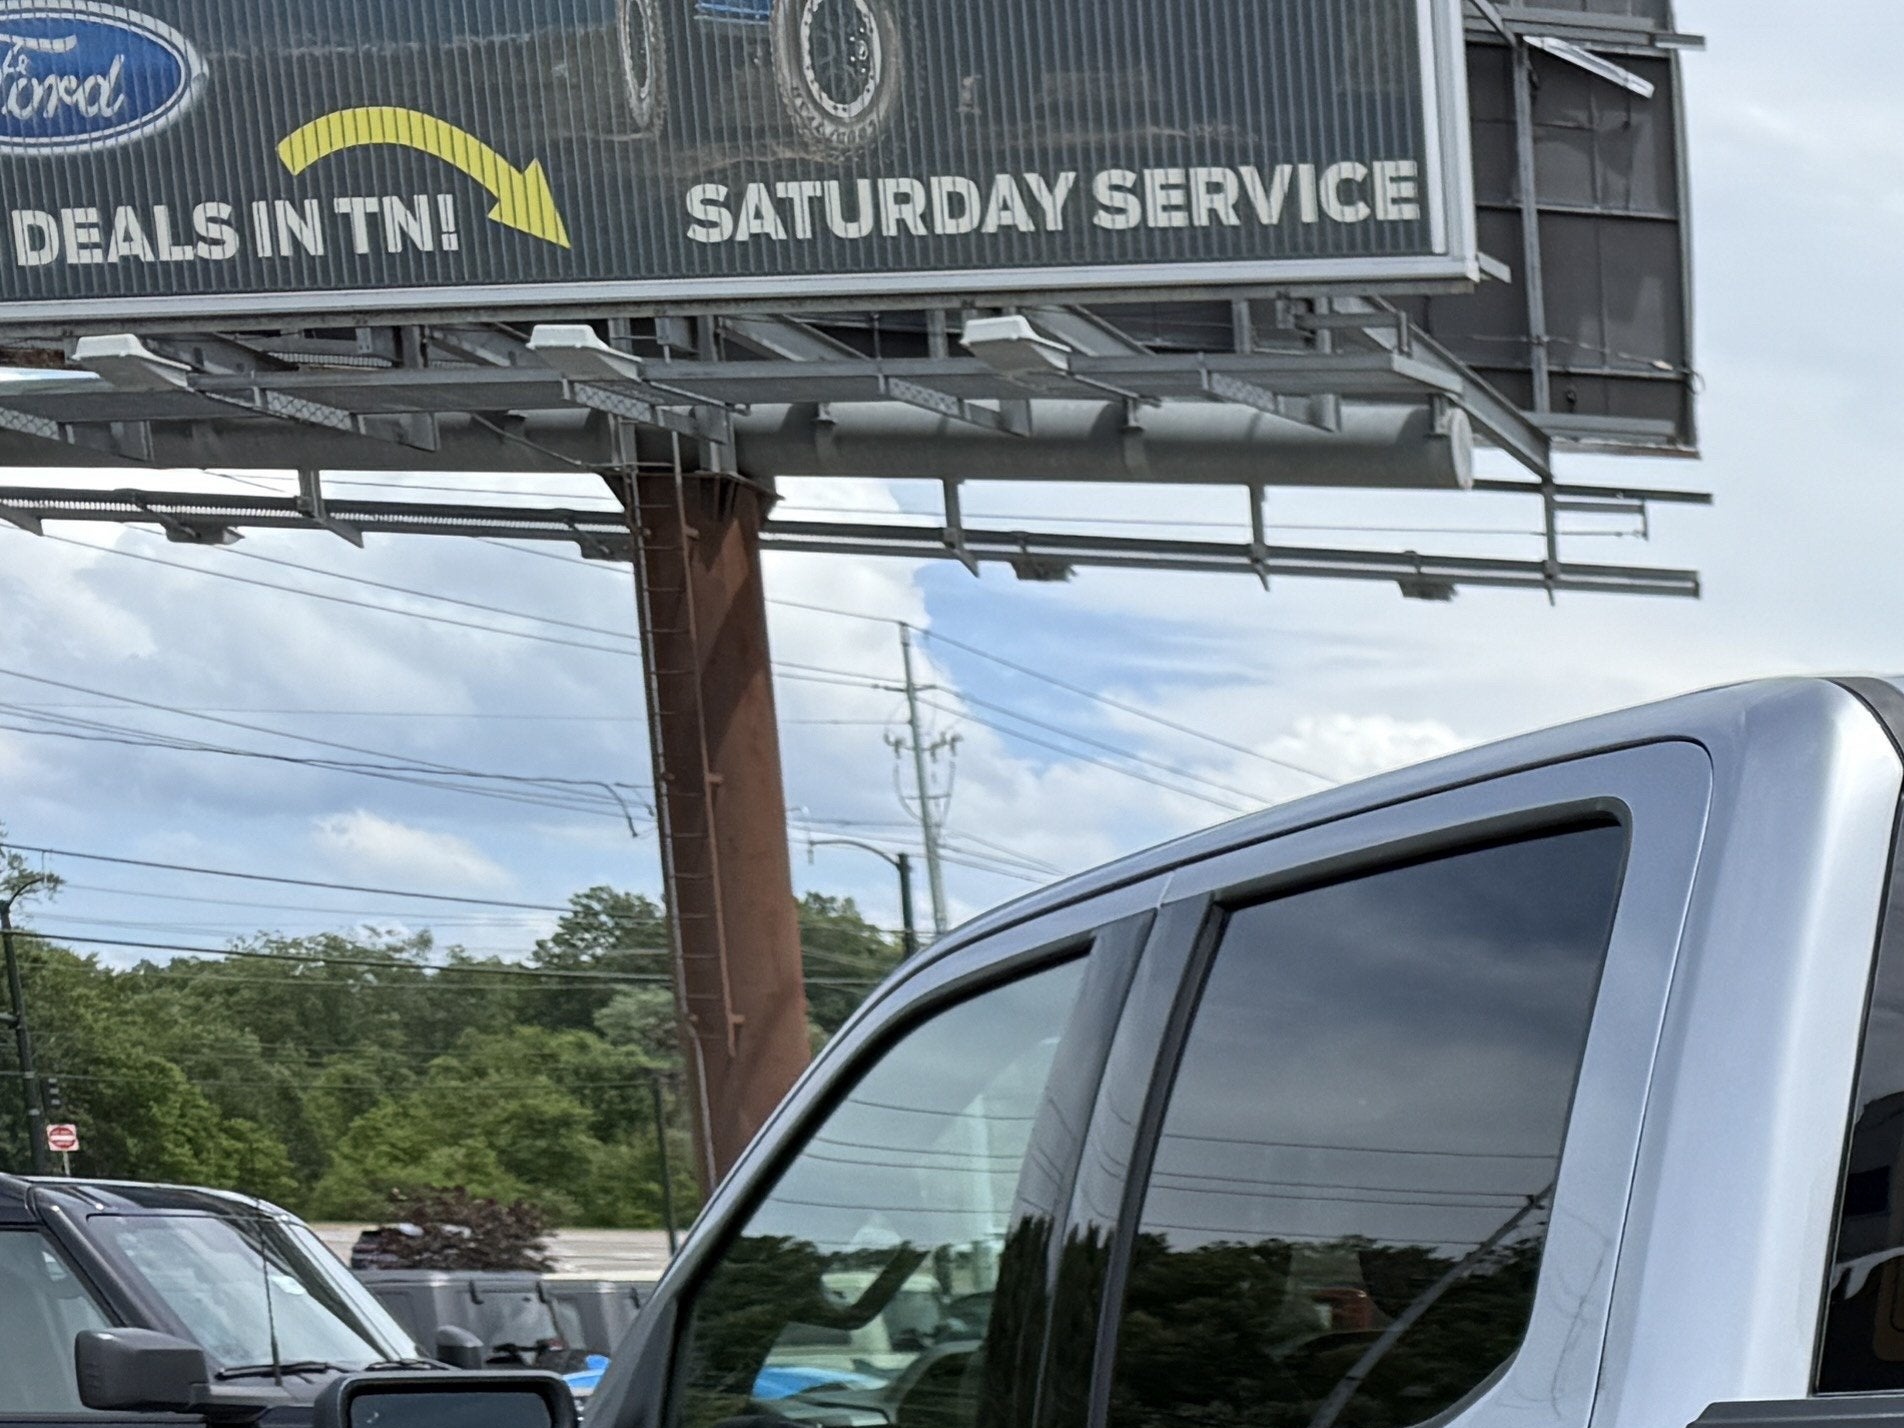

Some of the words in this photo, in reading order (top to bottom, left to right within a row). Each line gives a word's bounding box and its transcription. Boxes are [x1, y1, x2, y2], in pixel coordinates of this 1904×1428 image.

[11, 200, 239, 268] DEALS
[251, 198, 326, 260] IN
[332, 193, 460, 256] TN!
[686, 169, 1077, 246] SATURDAY
[1092, 158, 1421, 232] SERVICE
